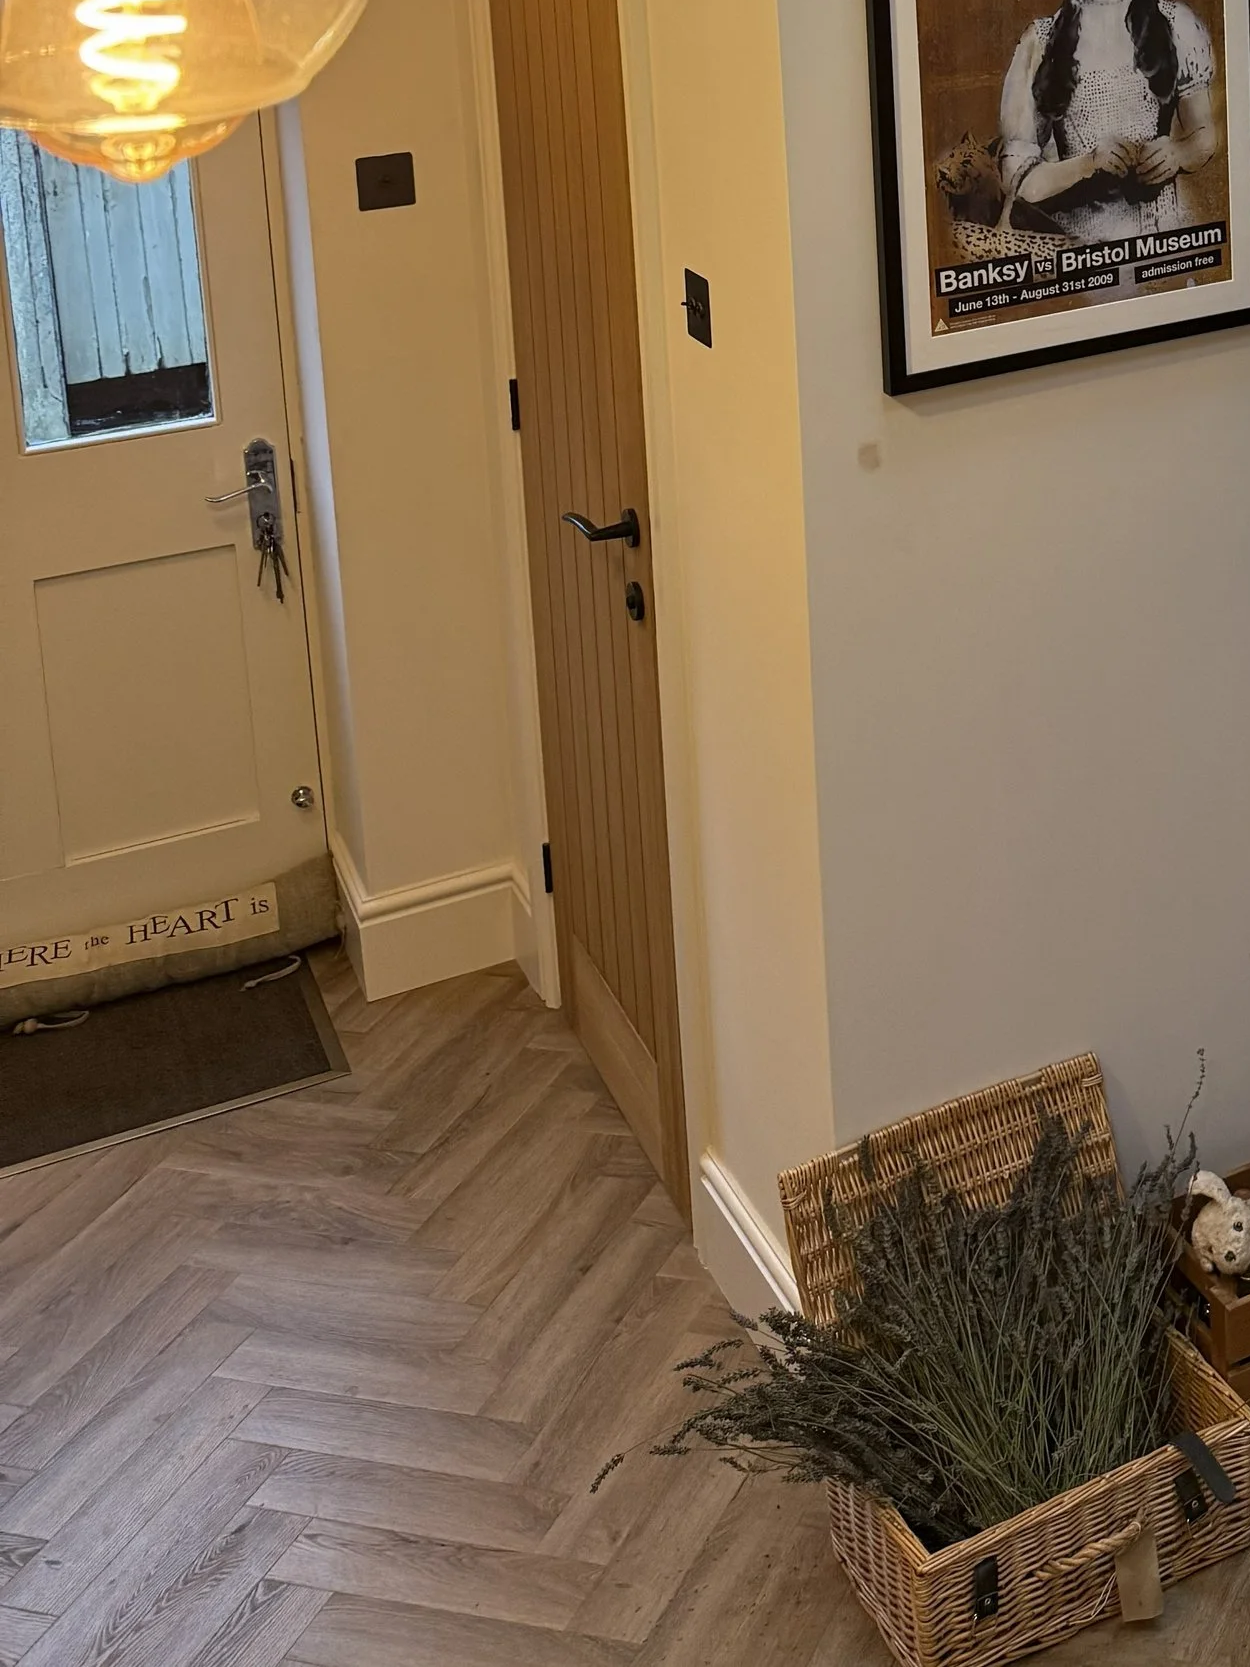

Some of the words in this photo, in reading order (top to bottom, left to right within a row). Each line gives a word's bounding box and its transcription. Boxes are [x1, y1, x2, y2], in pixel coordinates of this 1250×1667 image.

[939, 260, 1029, 293] Banksy
[1036, 261, 1052, 272] vs
[1061, 241, 1130, 272] Bristol
[1136, 228, 1222, 258] Museum
[1141, 260, 1192, 279] admission
[1194, 255, 1214, 267] free
[954, 300, 983, 313] June
[985, 294, 1010, 307] 13th
[1020, 283, 1060, 300] August
[1062, 279, 1085, 292] 31st
[1087, 273, 1113, 287] 2009
[0, 939, 72, 972] ERE
[84, 935, 110, 950] the
[125, 898, 239, 945] HEART
[250, 897, 270, 916] is
